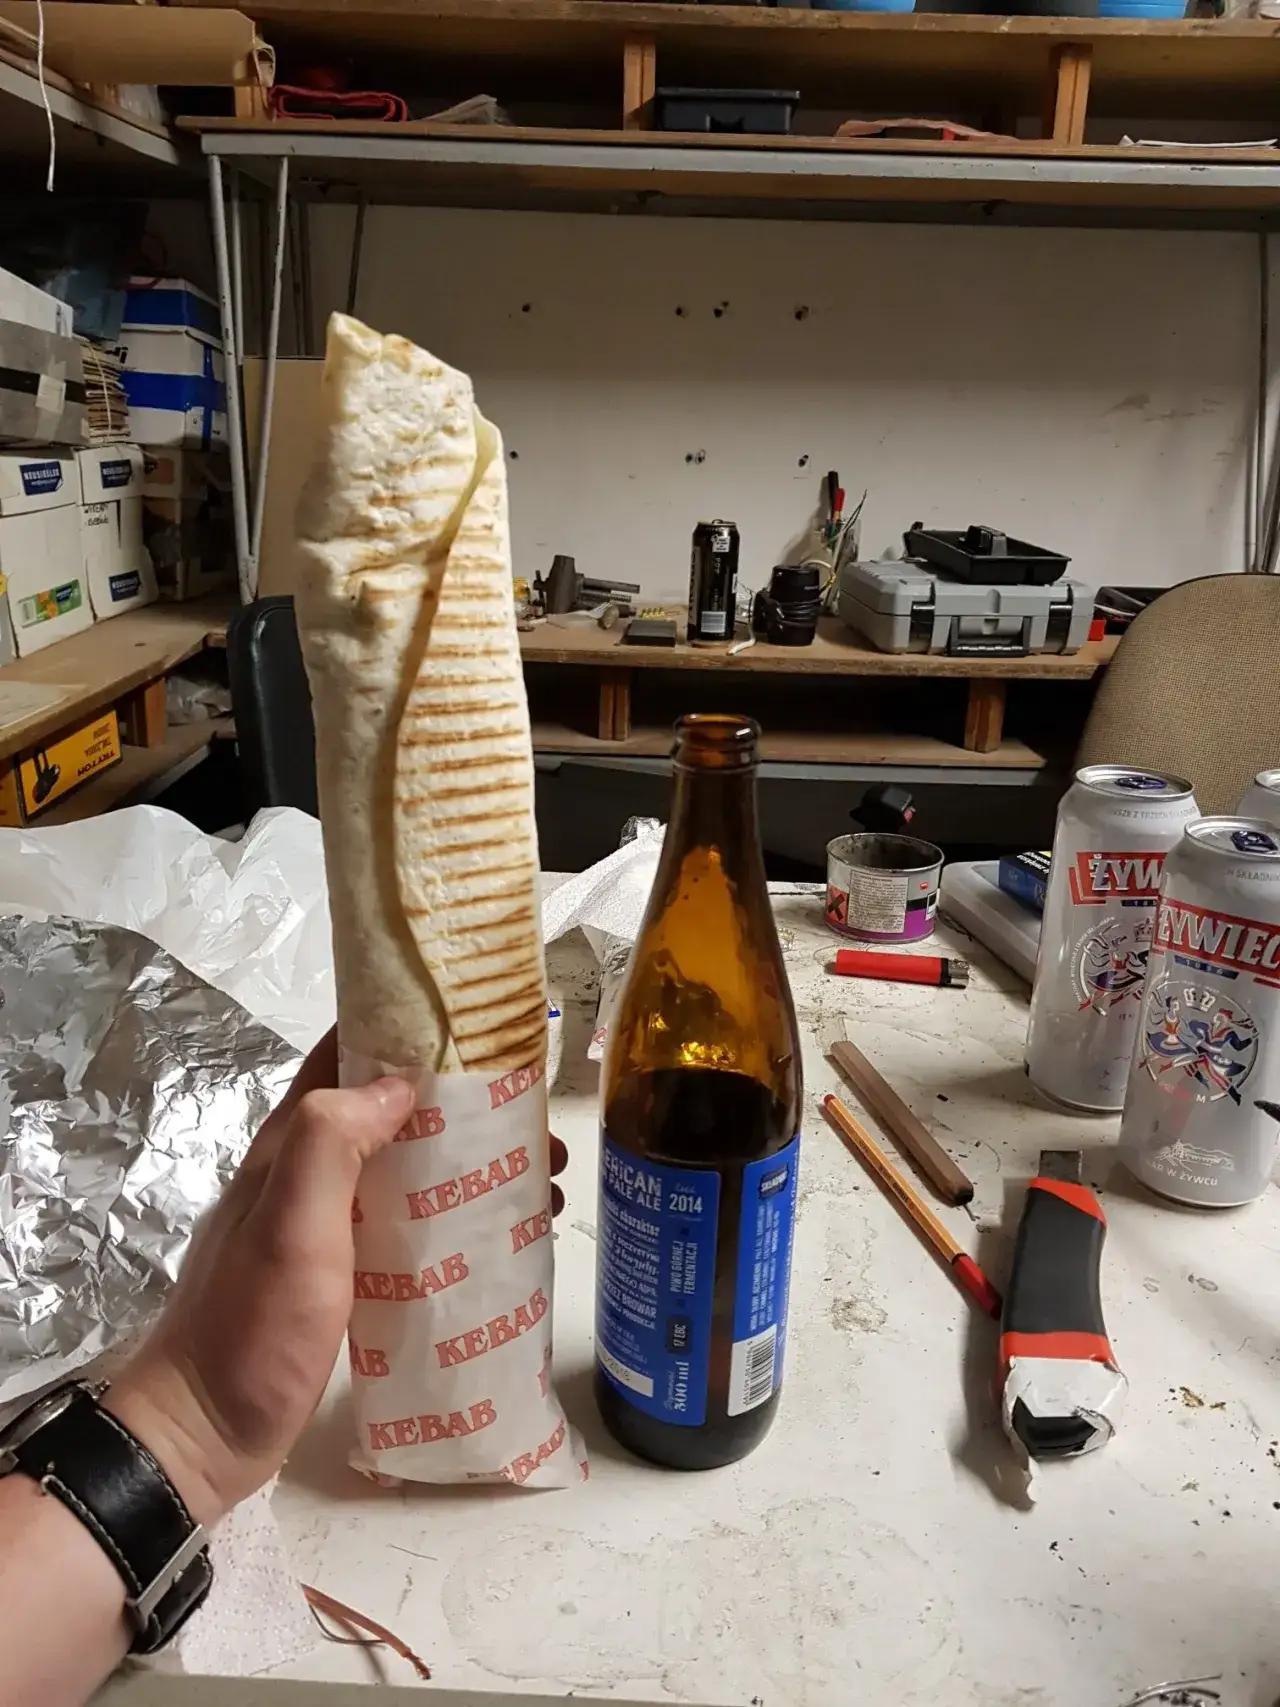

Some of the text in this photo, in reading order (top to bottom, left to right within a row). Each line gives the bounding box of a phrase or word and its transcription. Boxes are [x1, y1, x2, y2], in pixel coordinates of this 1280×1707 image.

[406, 1145, 530, 1221] KEBAB
[635, 1191, 662, 1212] ALE
[668, 1192, 704, 1214] 2014
[354, 1252, 469, 1302] KEBAB
[670, 1239, 685, 1293] PIWO GÓRNEJ
[683, 1242, 699, 1295] FERMENTACJI
[434, 1287, 548, 1369] KEBAB
[673, 1361, 690, 1412] 500 ml
[367, 1398, 498, 1451] KEBAB
